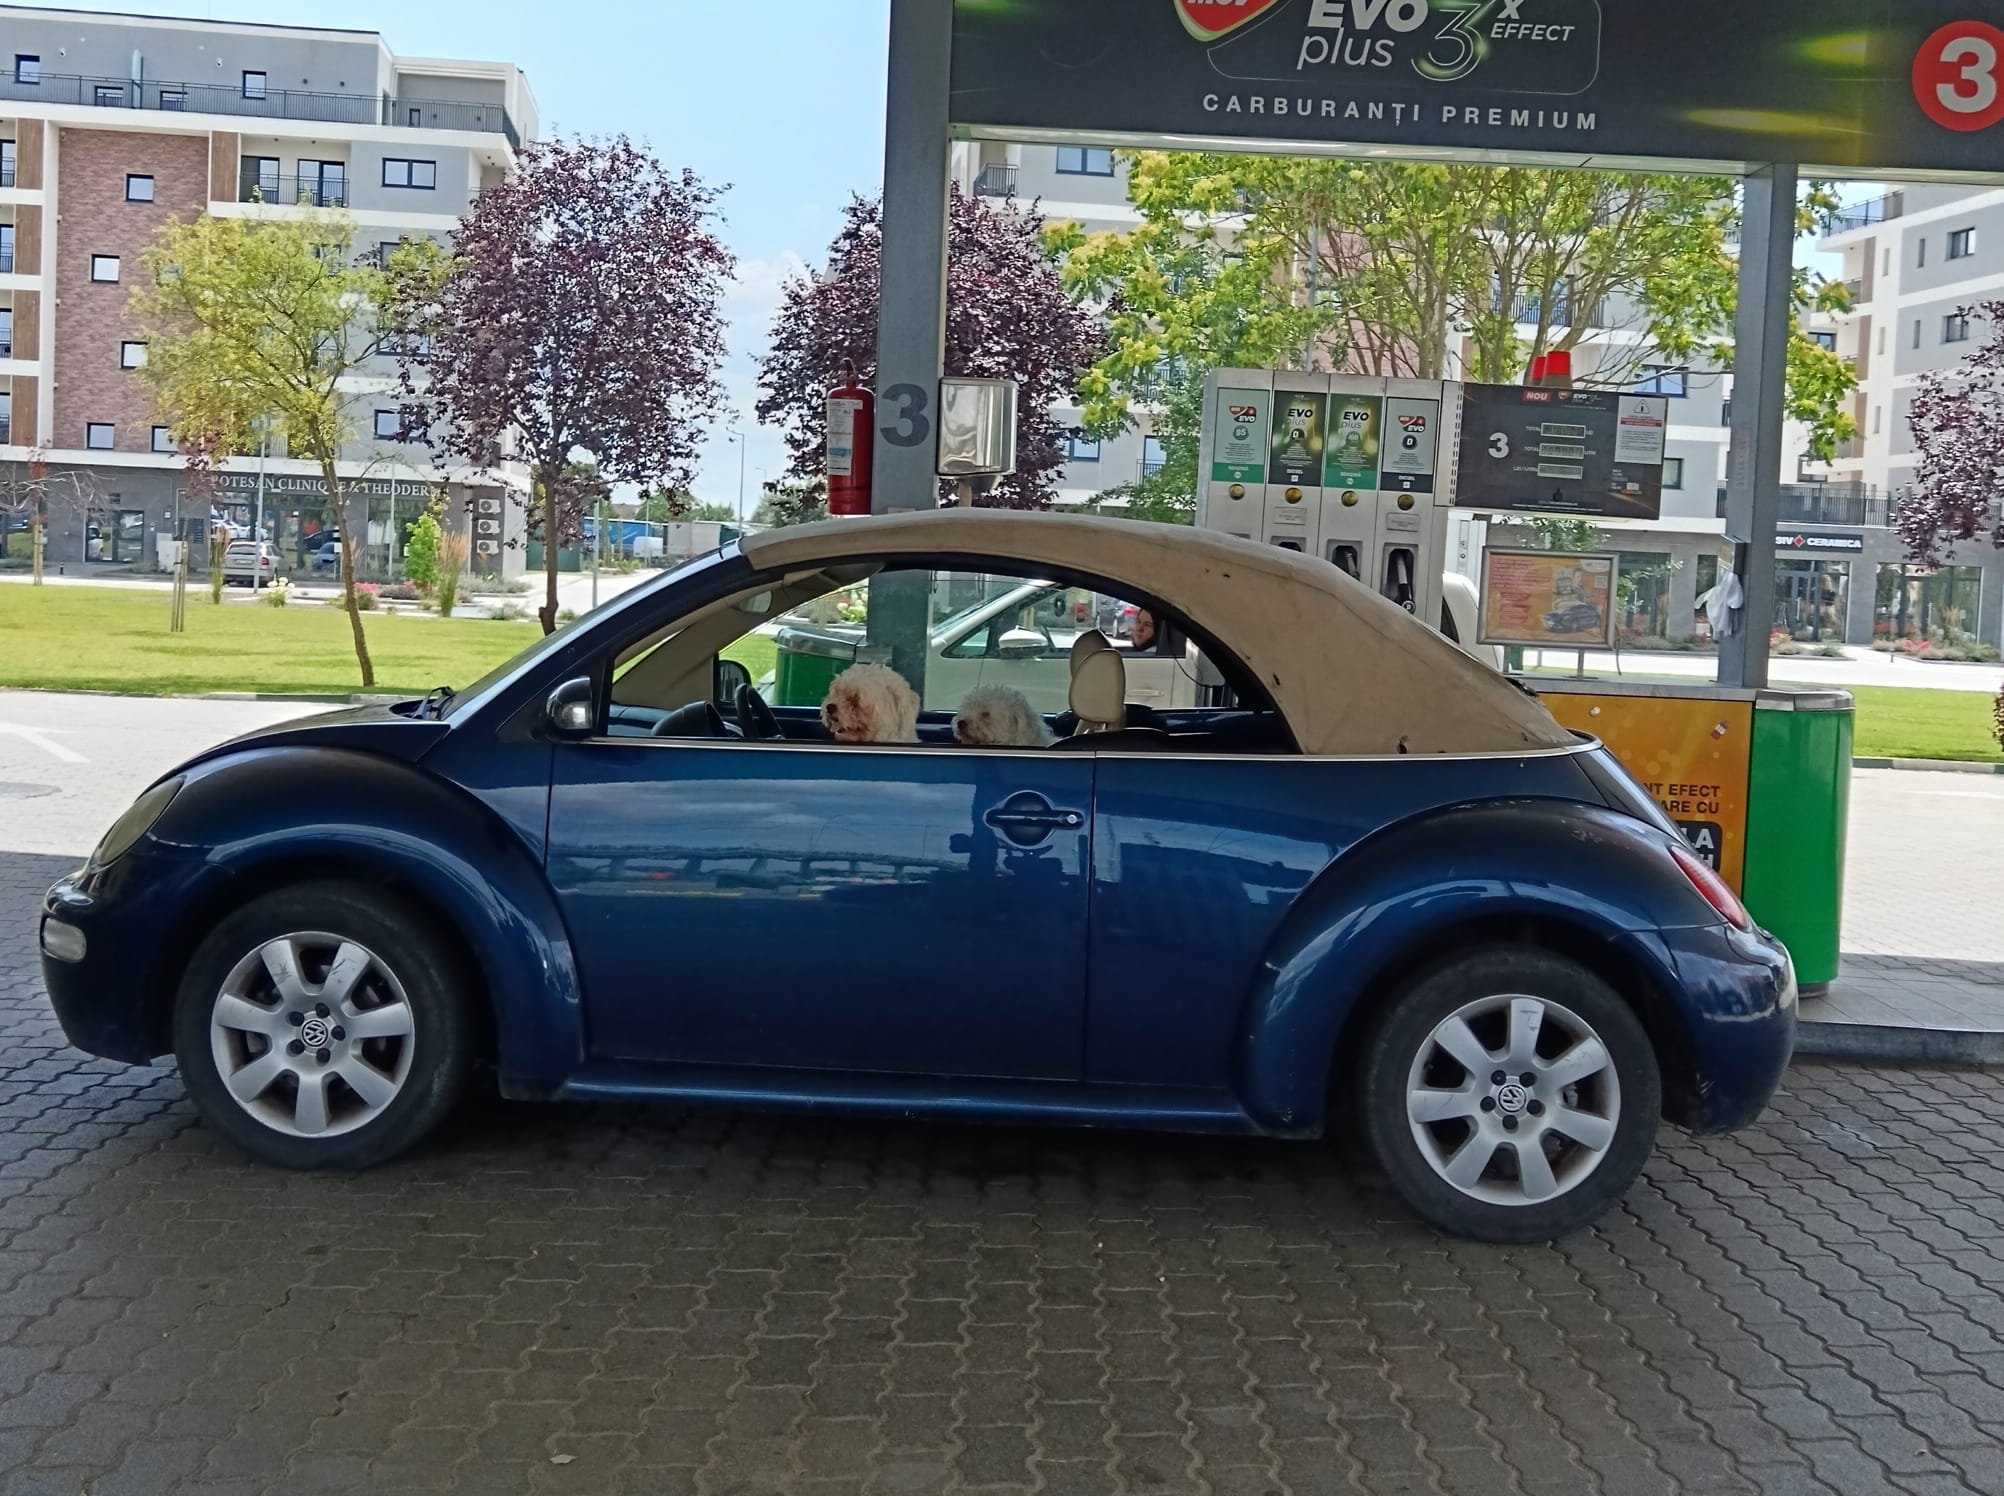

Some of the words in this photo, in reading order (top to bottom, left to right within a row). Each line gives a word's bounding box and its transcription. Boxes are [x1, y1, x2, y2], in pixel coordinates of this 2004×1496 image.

[1307, 0, 1429, 33] EVO
[1296, 27, 1396, 71] plus
[1490, 22, 1576, 42] EFFECT
[1935, 36, 1998, 114] 3
[1202, 93, 1420, 126] CARBURANȚI
[1441, 105, 1597, 131] PREMIUM
[1525, 391, 1548, 401] NOU
[879, 383, 931, 448] 3
[1238, 415, 1256, 423] EVO
[1287, 408, 1314, 418] EVO
[1343, 411, 1370, 421] EVO
[1340, 421, 1362, 429] plus
[1487, 431, 1510, 459] 3
[278, 479, 347, 495] CLINIQE
[1806, 538, 1862, 548] CERAMICA
[1668, 783, 1721, 798] EFECT
[1697, 801, 1720, 814] CU
